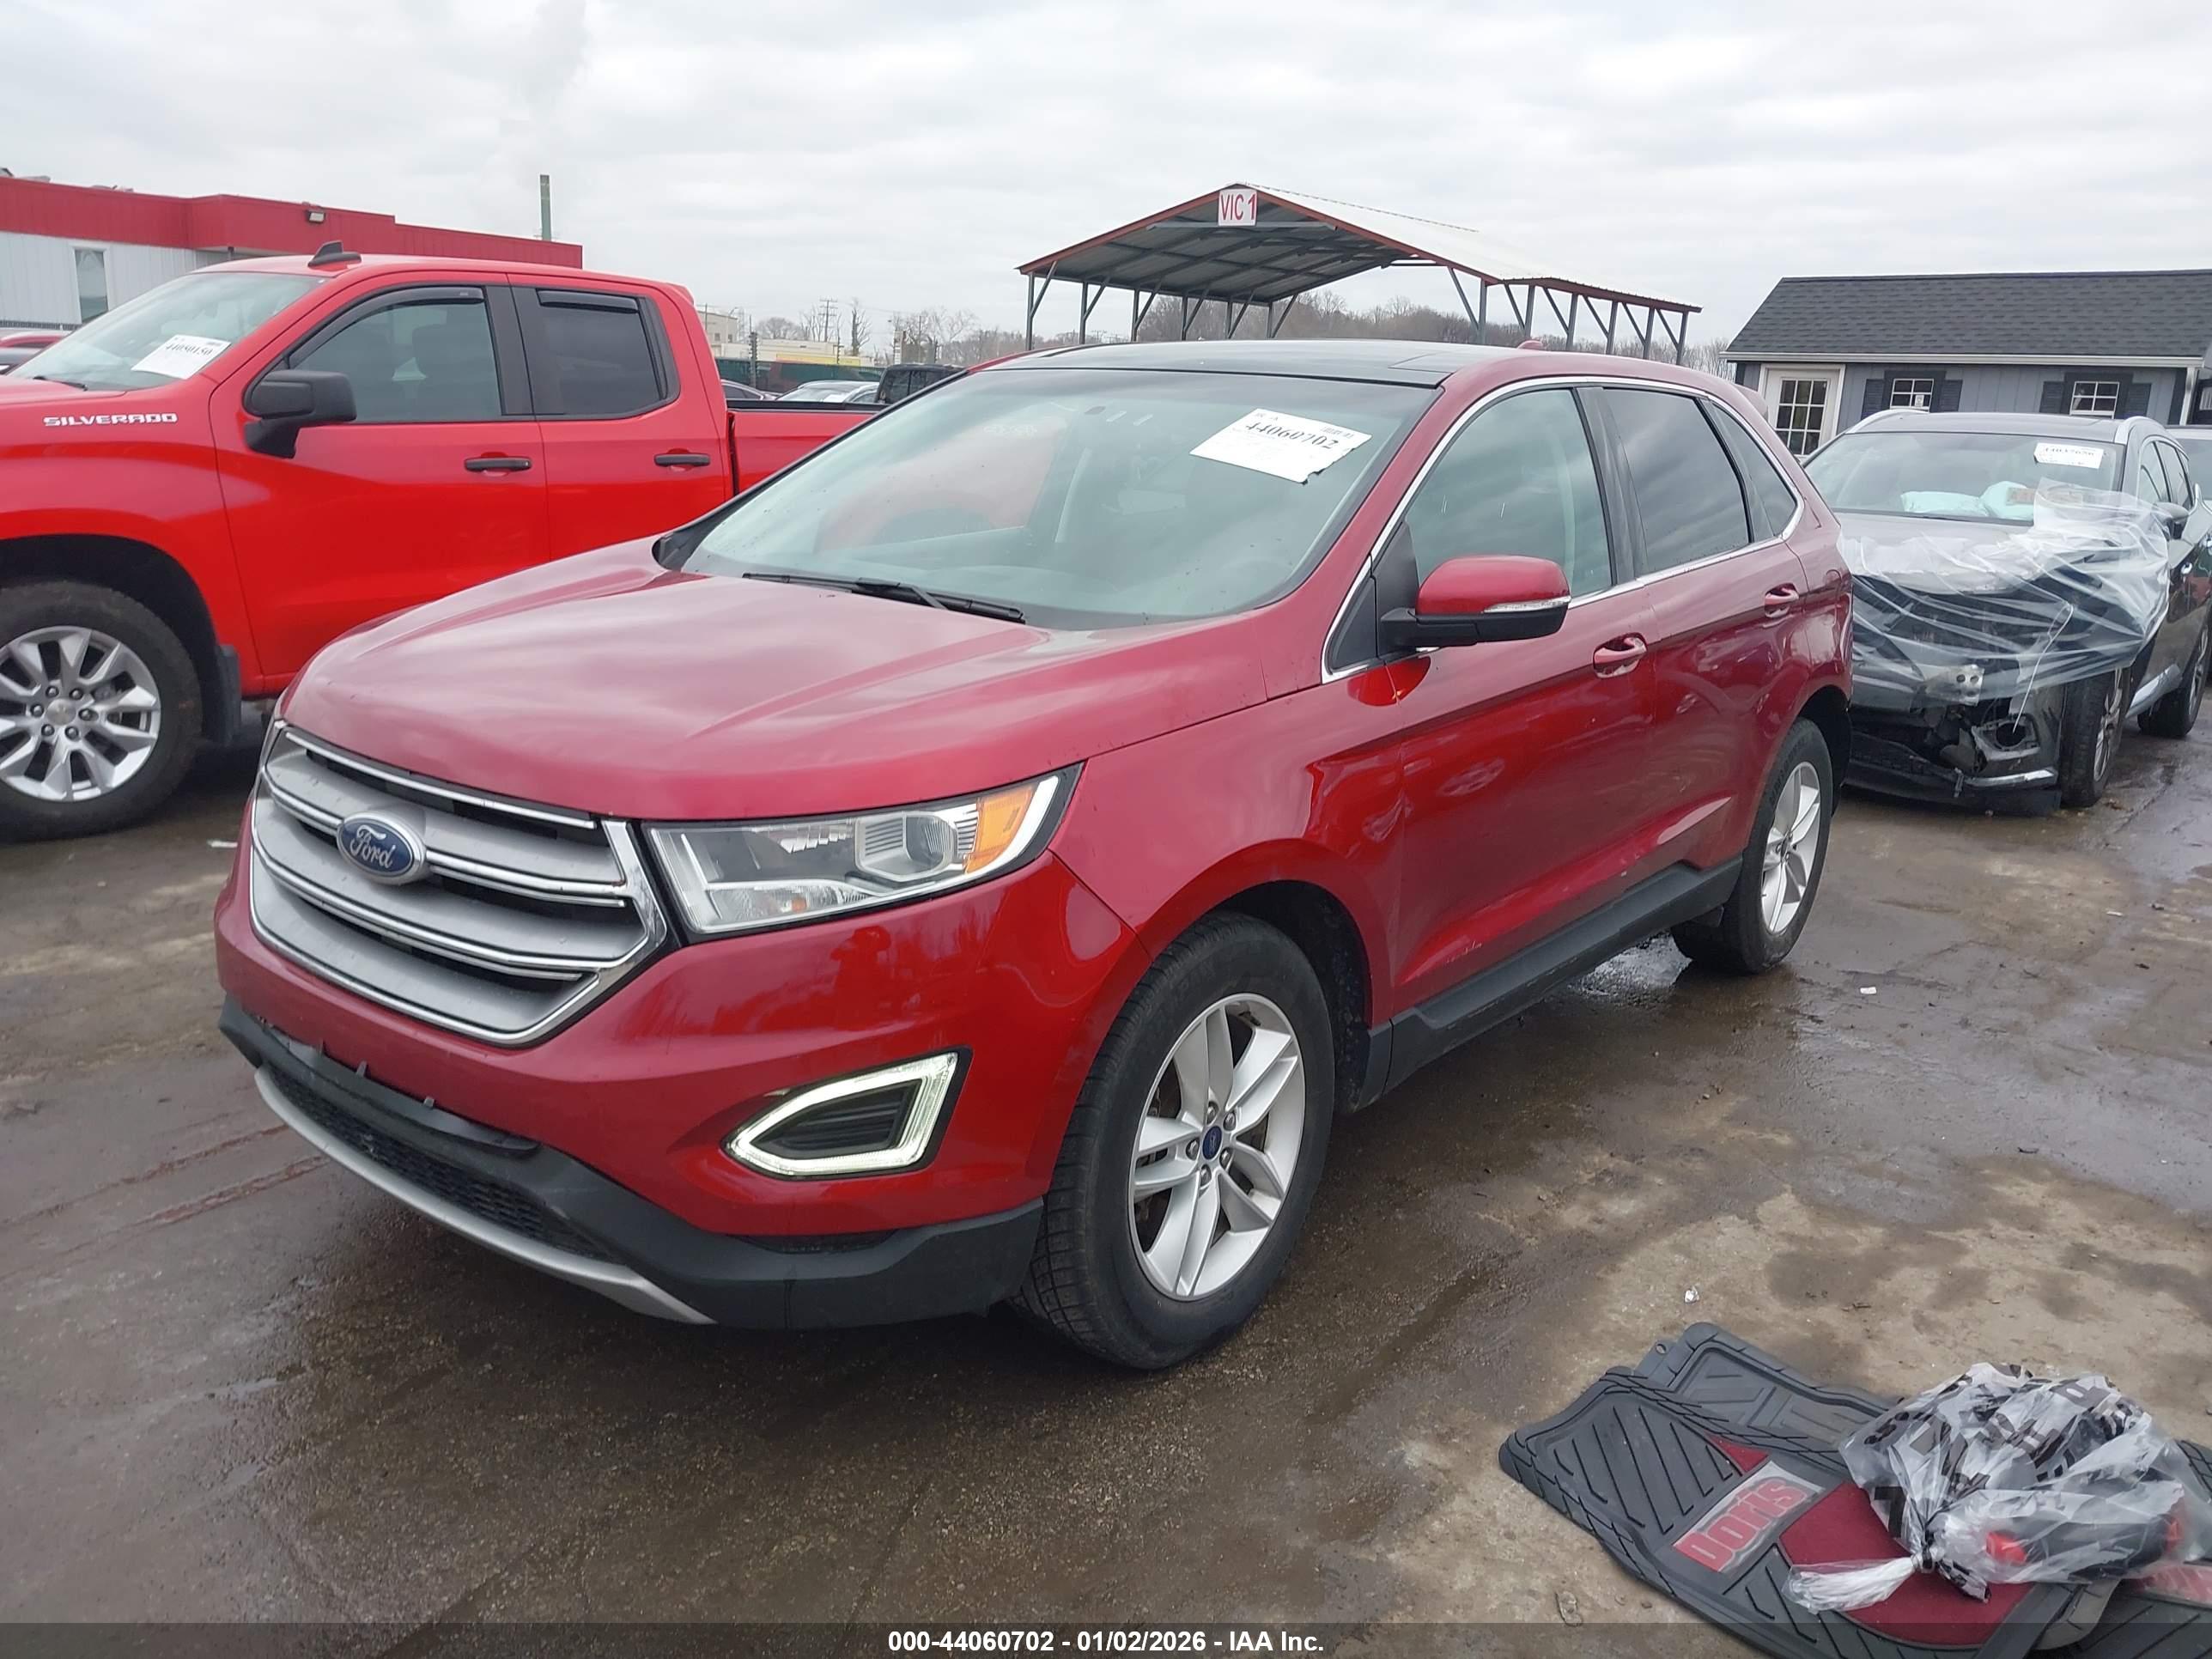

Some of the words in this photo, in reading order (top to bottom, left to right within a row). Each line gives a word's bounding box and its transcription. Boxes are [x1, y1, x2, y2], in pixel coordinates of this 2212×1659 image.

[1220, 193, 1244, 221] VIC
[1248, 193, 1256, 221] 1
[43, 412, 179, 427] SILVERADO
[1245, 422, 1339, 449] 44060702
[349, 824, 397, 869] Ford
